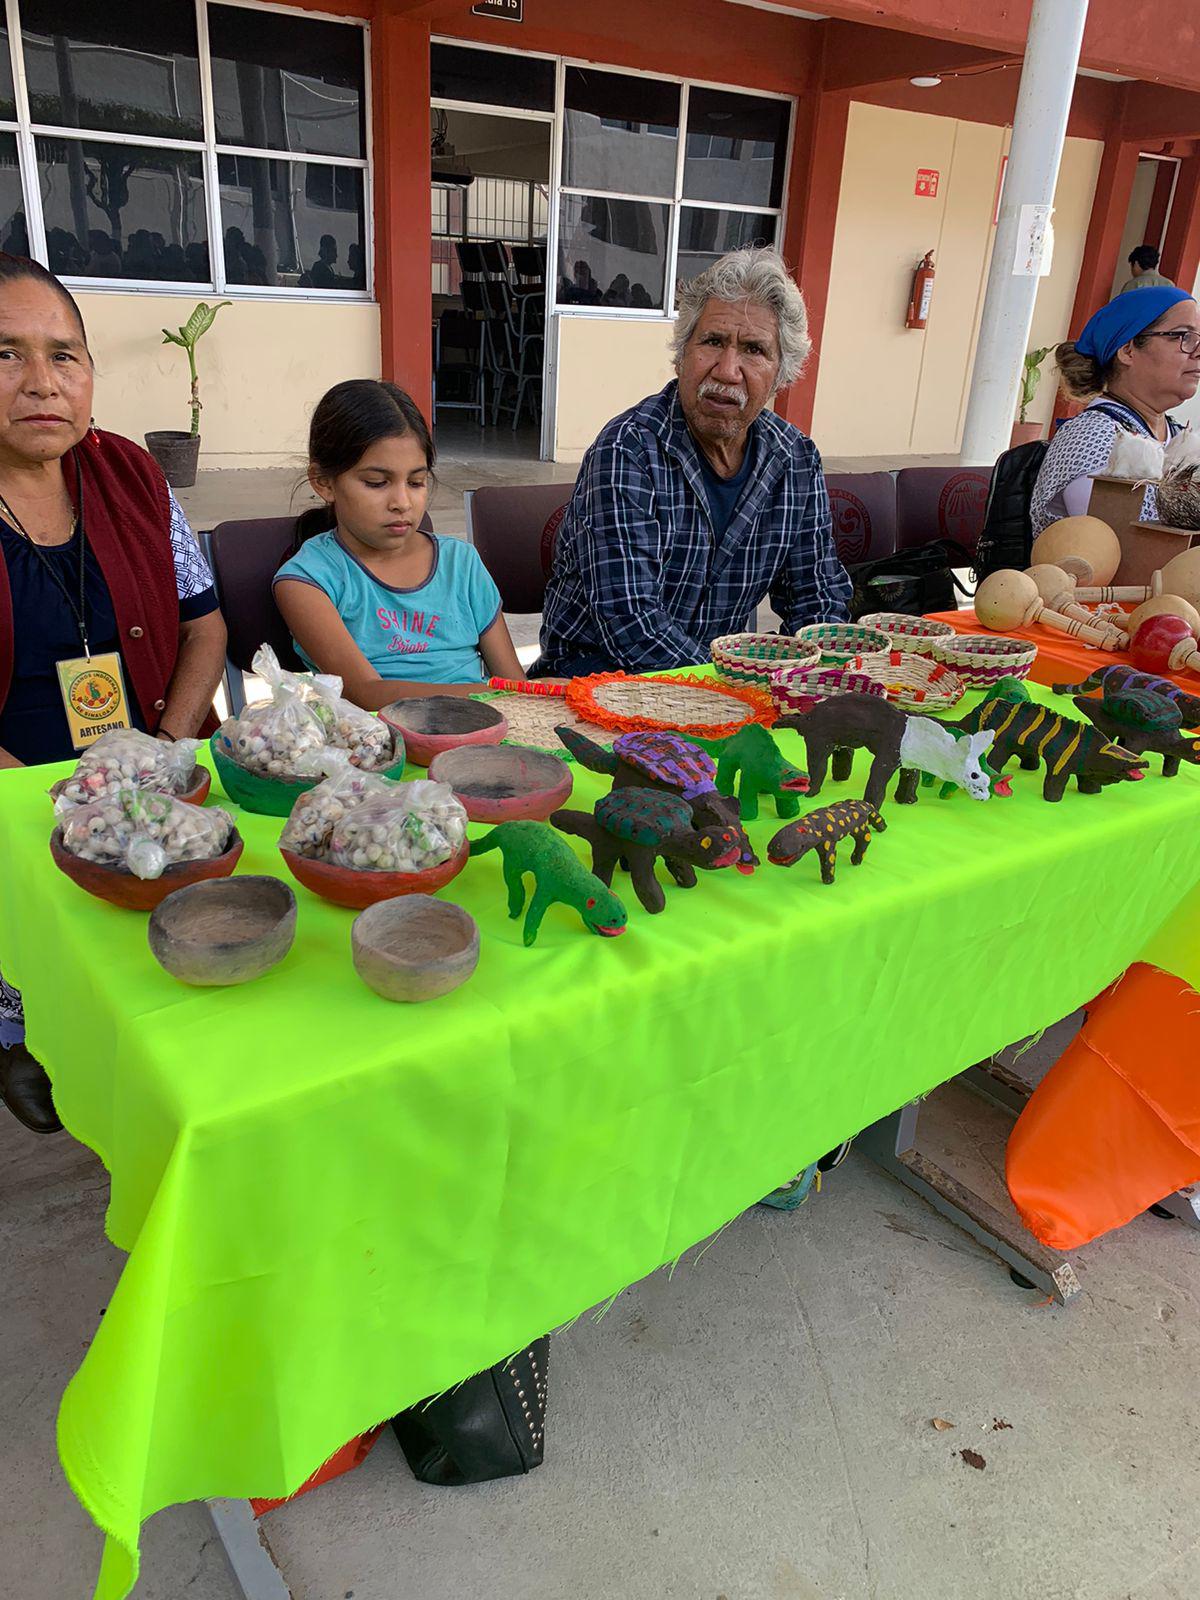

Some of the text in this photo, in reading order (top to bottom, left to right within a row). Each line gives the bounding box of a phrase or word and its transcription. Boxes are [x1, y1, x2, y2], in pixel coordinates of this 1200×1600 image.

[507, 0, 518, 8] 15
[376, 607, 441, 638] SHINE
[80, 720, 125, 738] ARTESANO
